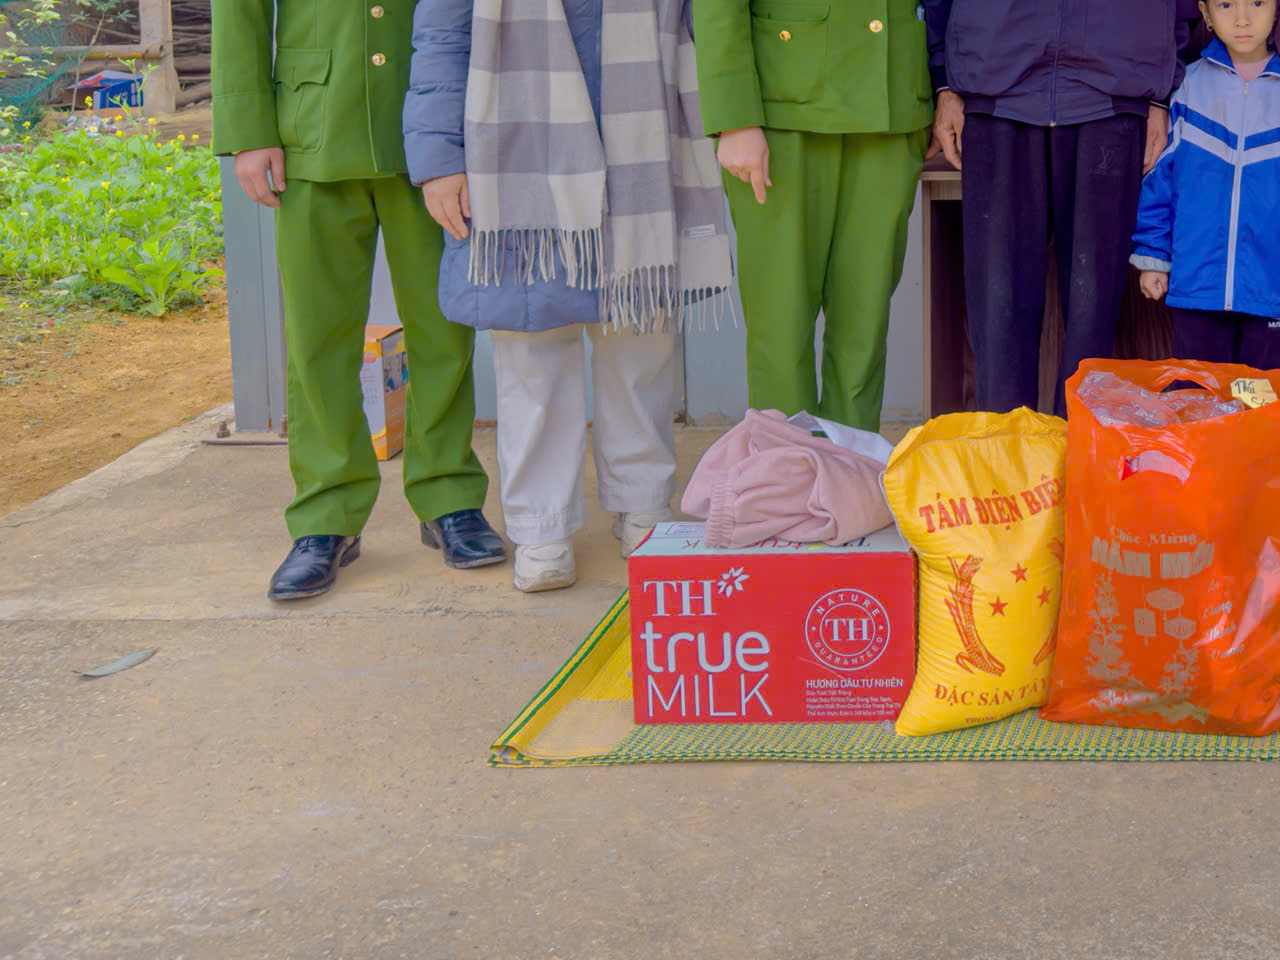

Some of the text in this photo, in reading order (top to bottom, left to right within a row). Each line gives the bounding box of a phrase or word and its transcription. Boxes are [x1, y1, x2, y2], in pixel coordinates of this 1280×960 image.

[919, 491, 973, 533] TÁM
[972, 489, 1024, 531] ĐIỆN
[643, 580, 717, 617] TH
[816, 593, 881, 618] NATURE
[640, 621, 770, 673] true
[824, 618, 871, 641] TH
[814, 637, 883, 665] GUARANTEED
[647, 673, 773, 717] MILK
